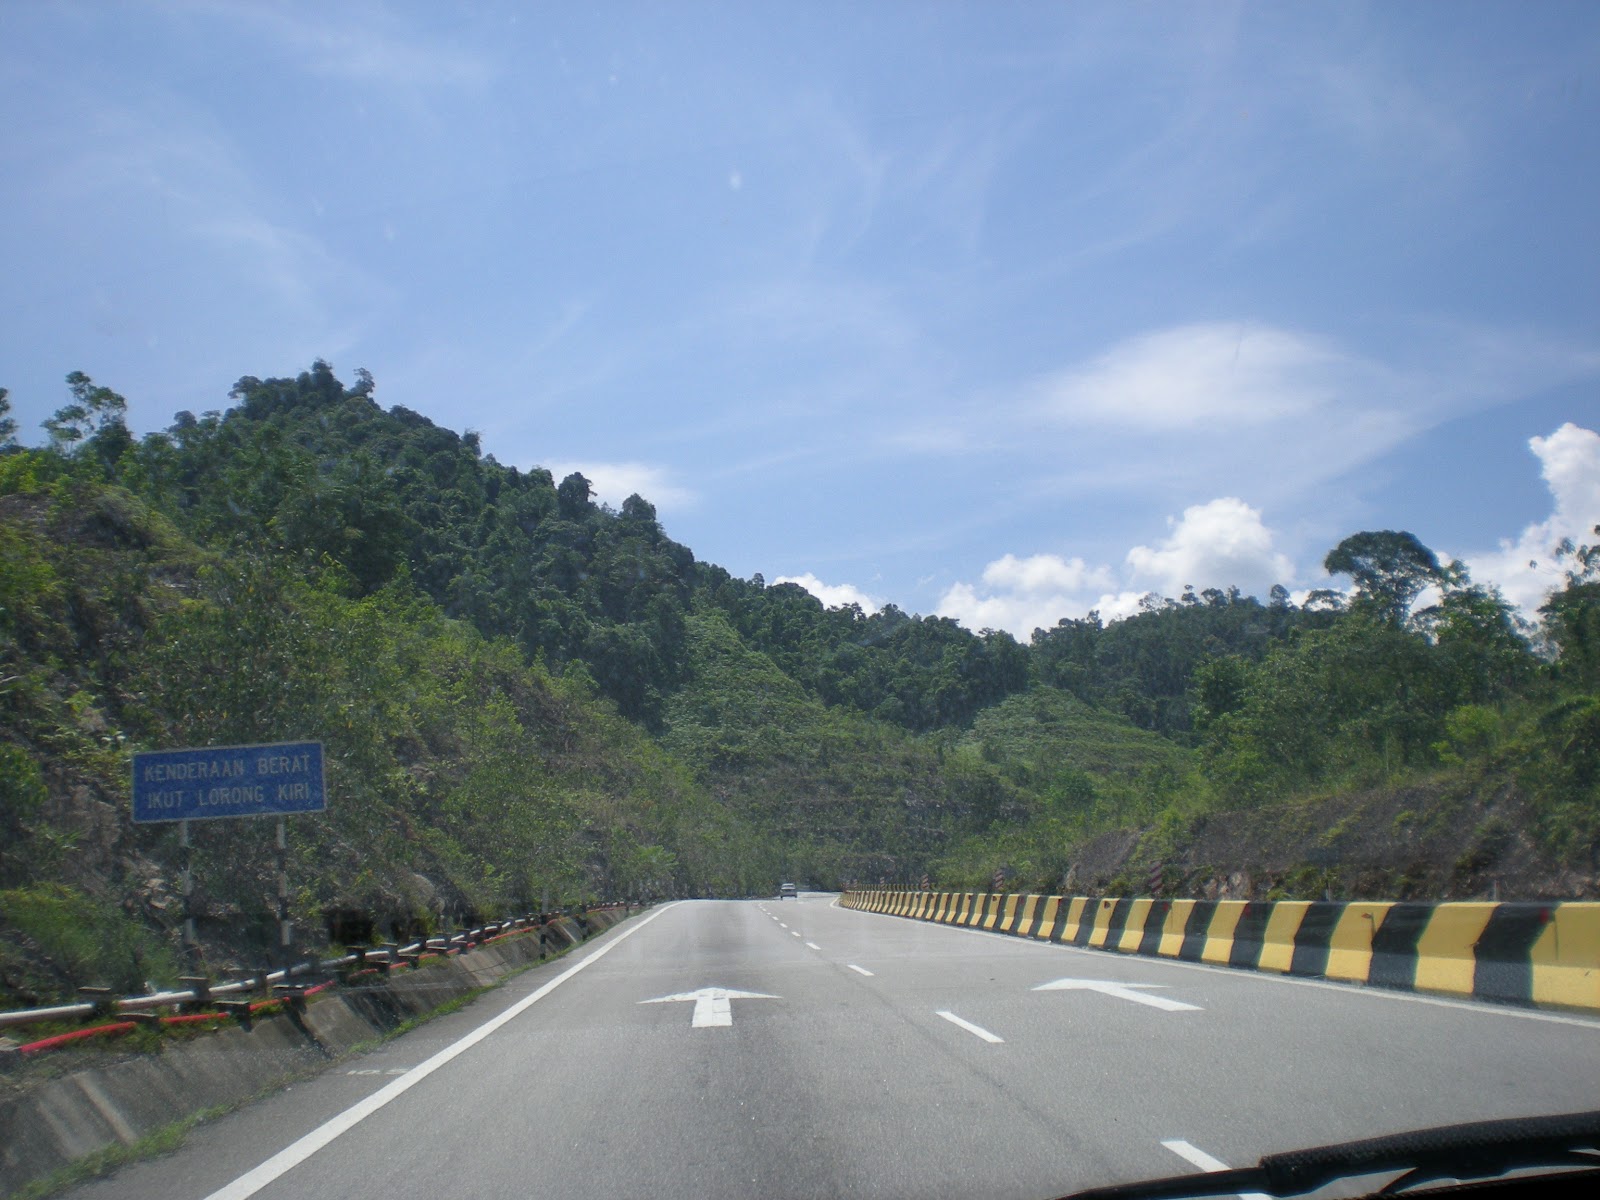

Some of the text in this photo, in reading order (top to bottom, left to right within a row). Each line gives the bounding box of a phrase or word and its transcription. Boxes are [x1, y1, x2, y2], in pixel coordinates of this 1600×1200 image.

[144, 755, 310, 782] KENDERAAN BERAT
[147, 783, 310, 809] IKUT LORONG KIRI
